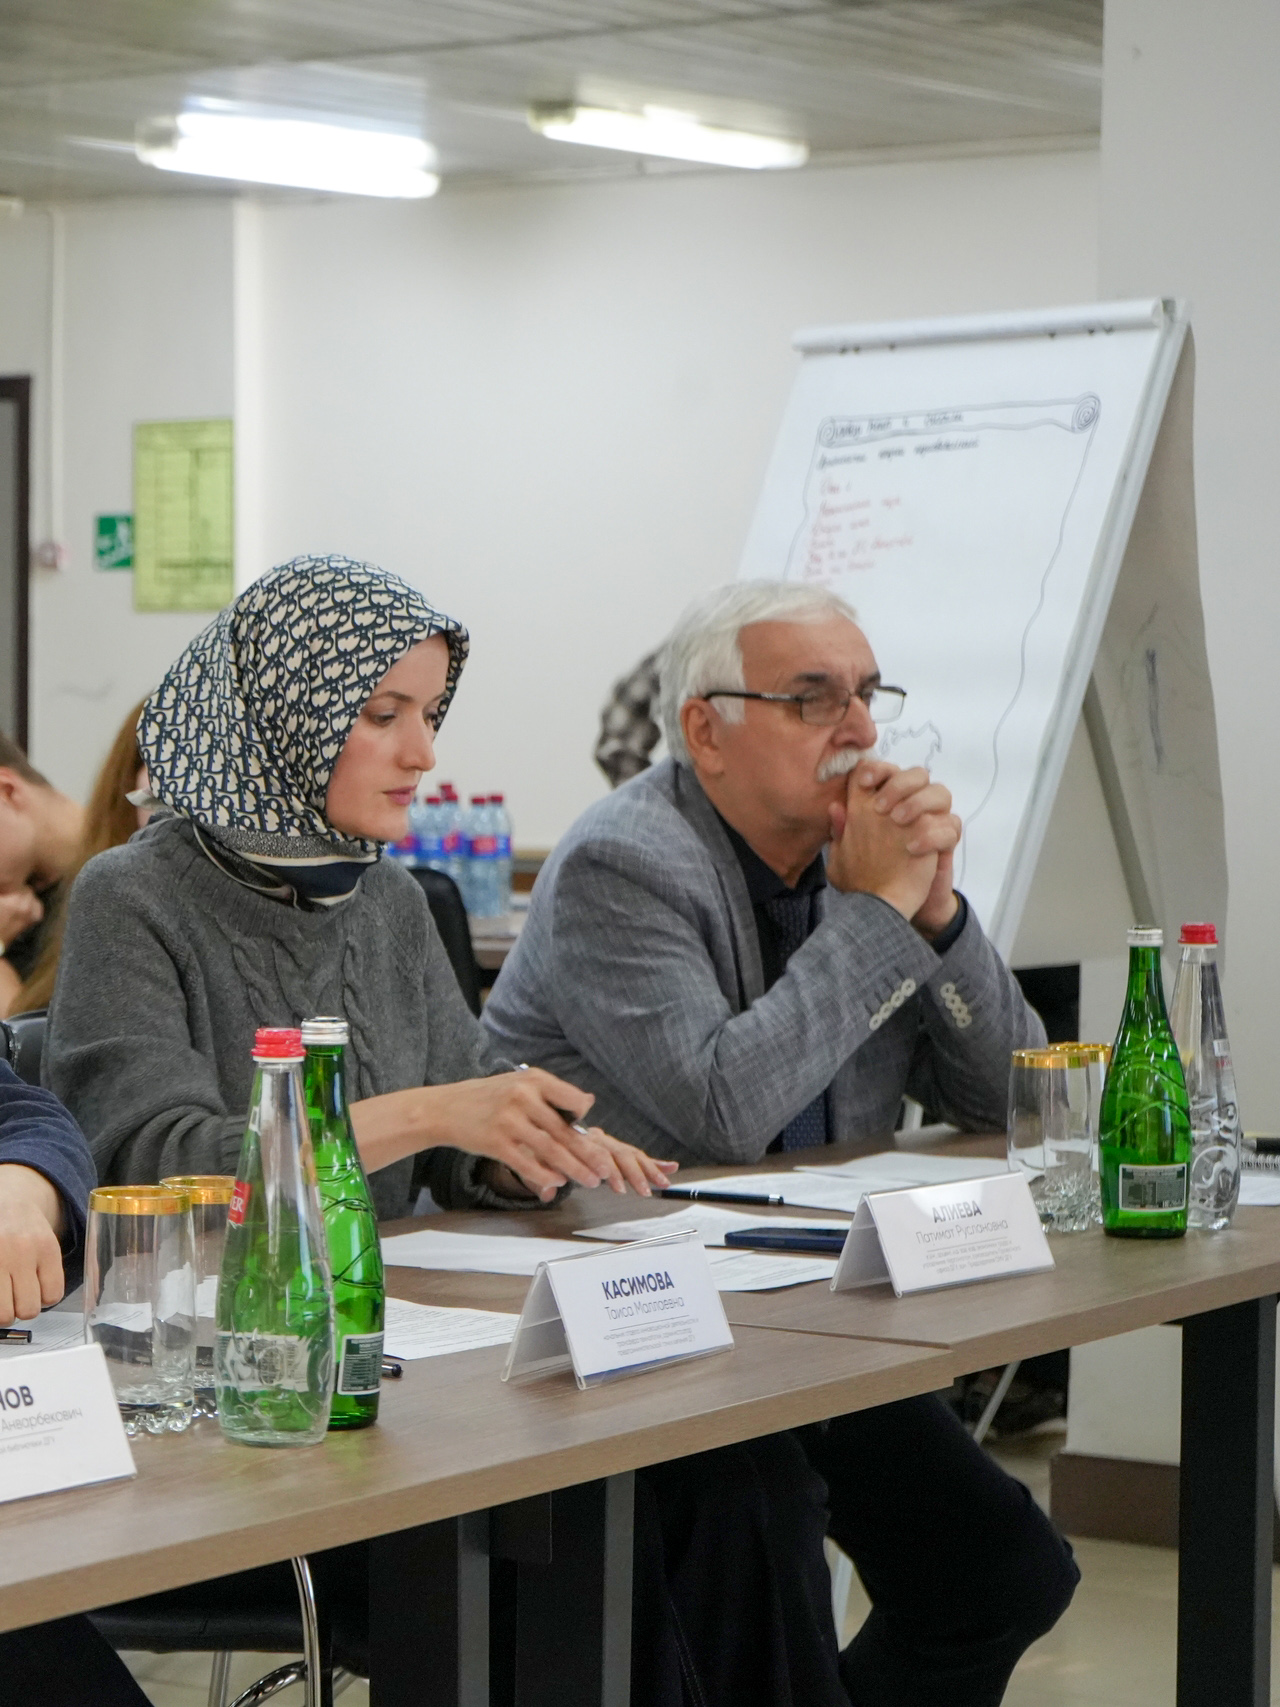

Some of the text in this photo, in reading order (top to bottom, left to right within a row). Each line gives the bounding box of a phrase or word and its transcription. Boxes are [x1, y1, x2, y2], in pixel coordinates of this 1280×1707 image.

[932, 1200, 982, 1223] АЛИЕВА
[915, 1219, 1009, 1244] Патимат Руслановна
[601, 1271, 675, 1300] КАСИМОВА
[604, 1296, 685, 1320] Таиса Маллаевна
[1, 1407, 83, 1433] Анварбекович
